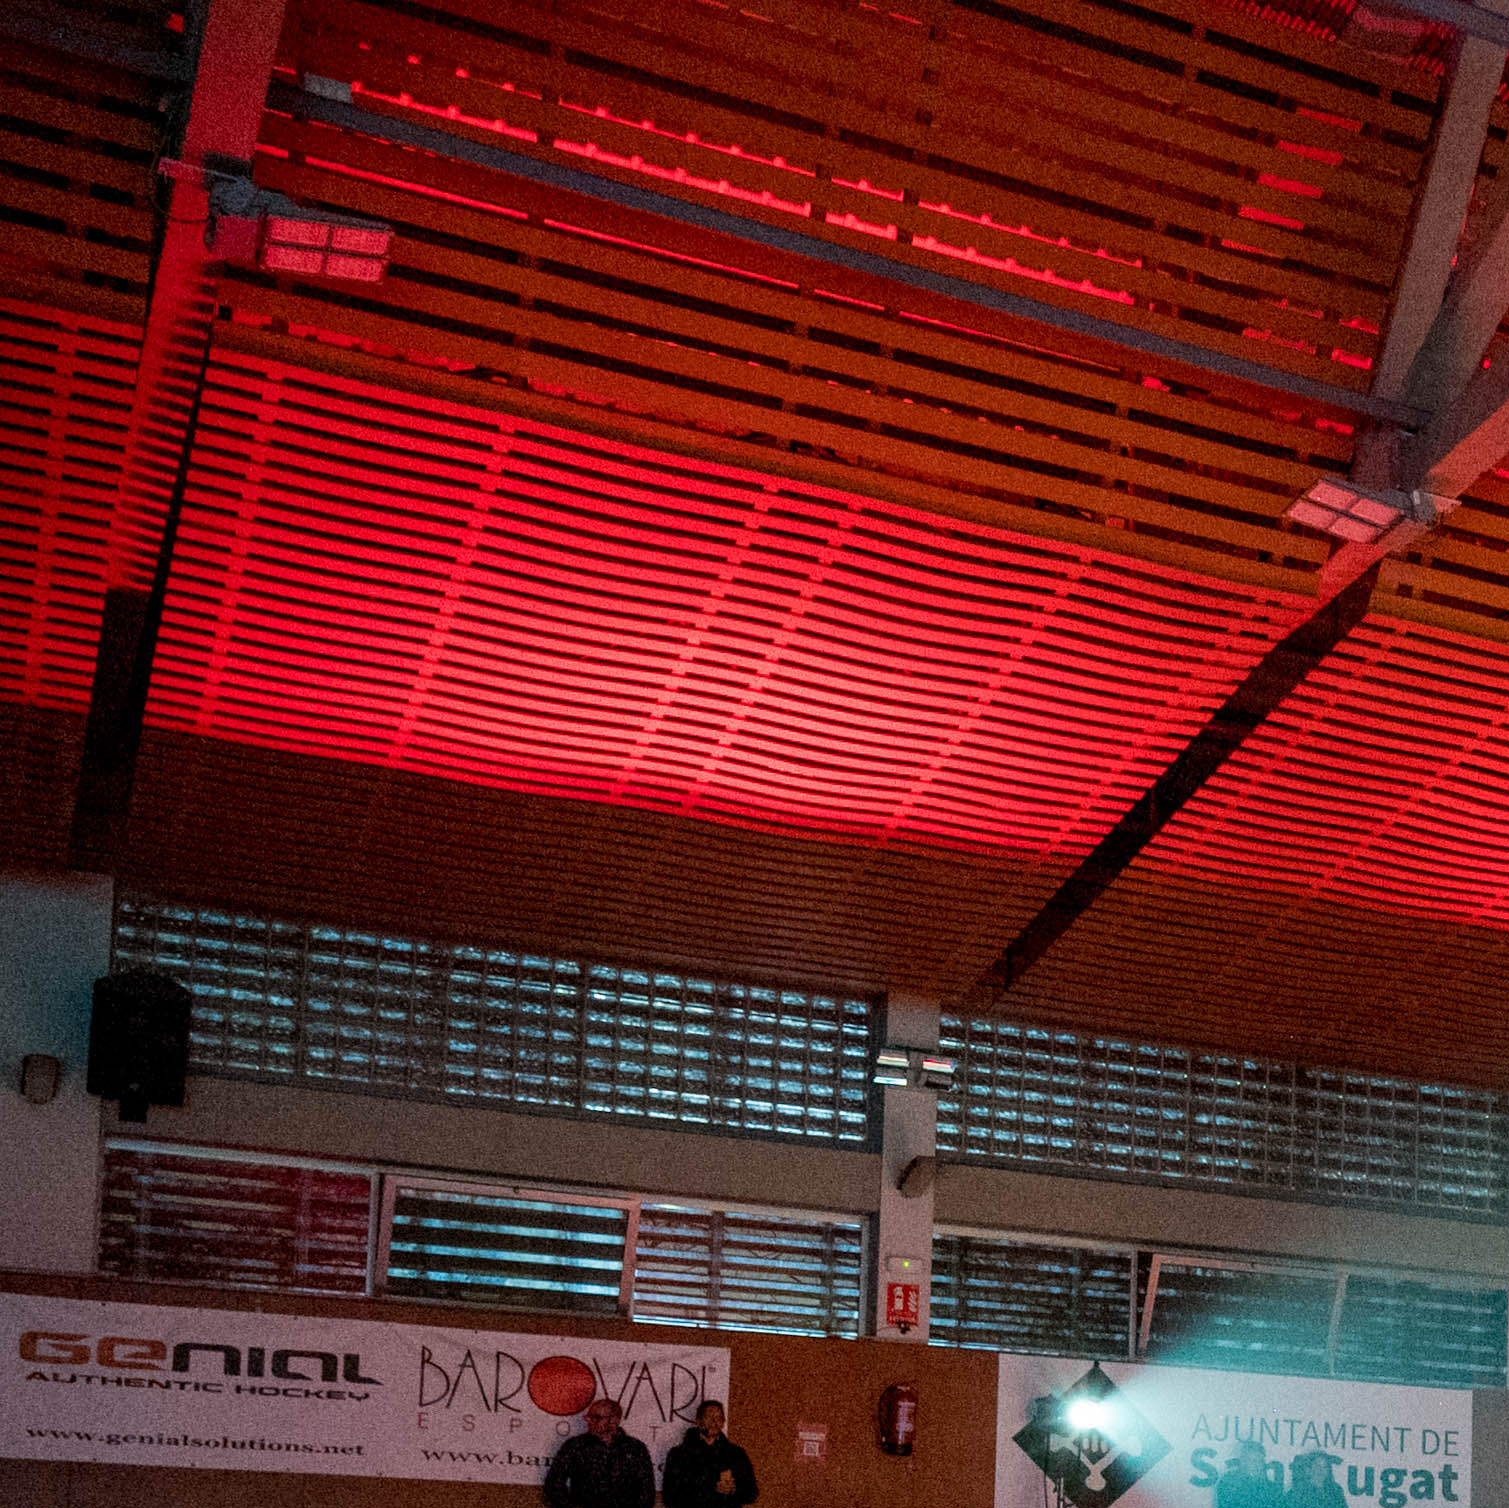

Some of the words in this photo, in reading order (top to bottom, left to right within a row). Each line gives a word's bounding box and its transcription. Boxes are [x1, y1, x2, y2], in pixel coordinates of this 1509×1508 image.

[26, 1371, 223, 1394] AUTHENTIC
[235, 1384, 370, 1401] HOCKEY
[27, 1427, 364, 1457] www.genialsolutions.net
[1191, 1413, 1412, 1454] AJUNTAMENT
[1421, 1428, 1460, 1458] DE
